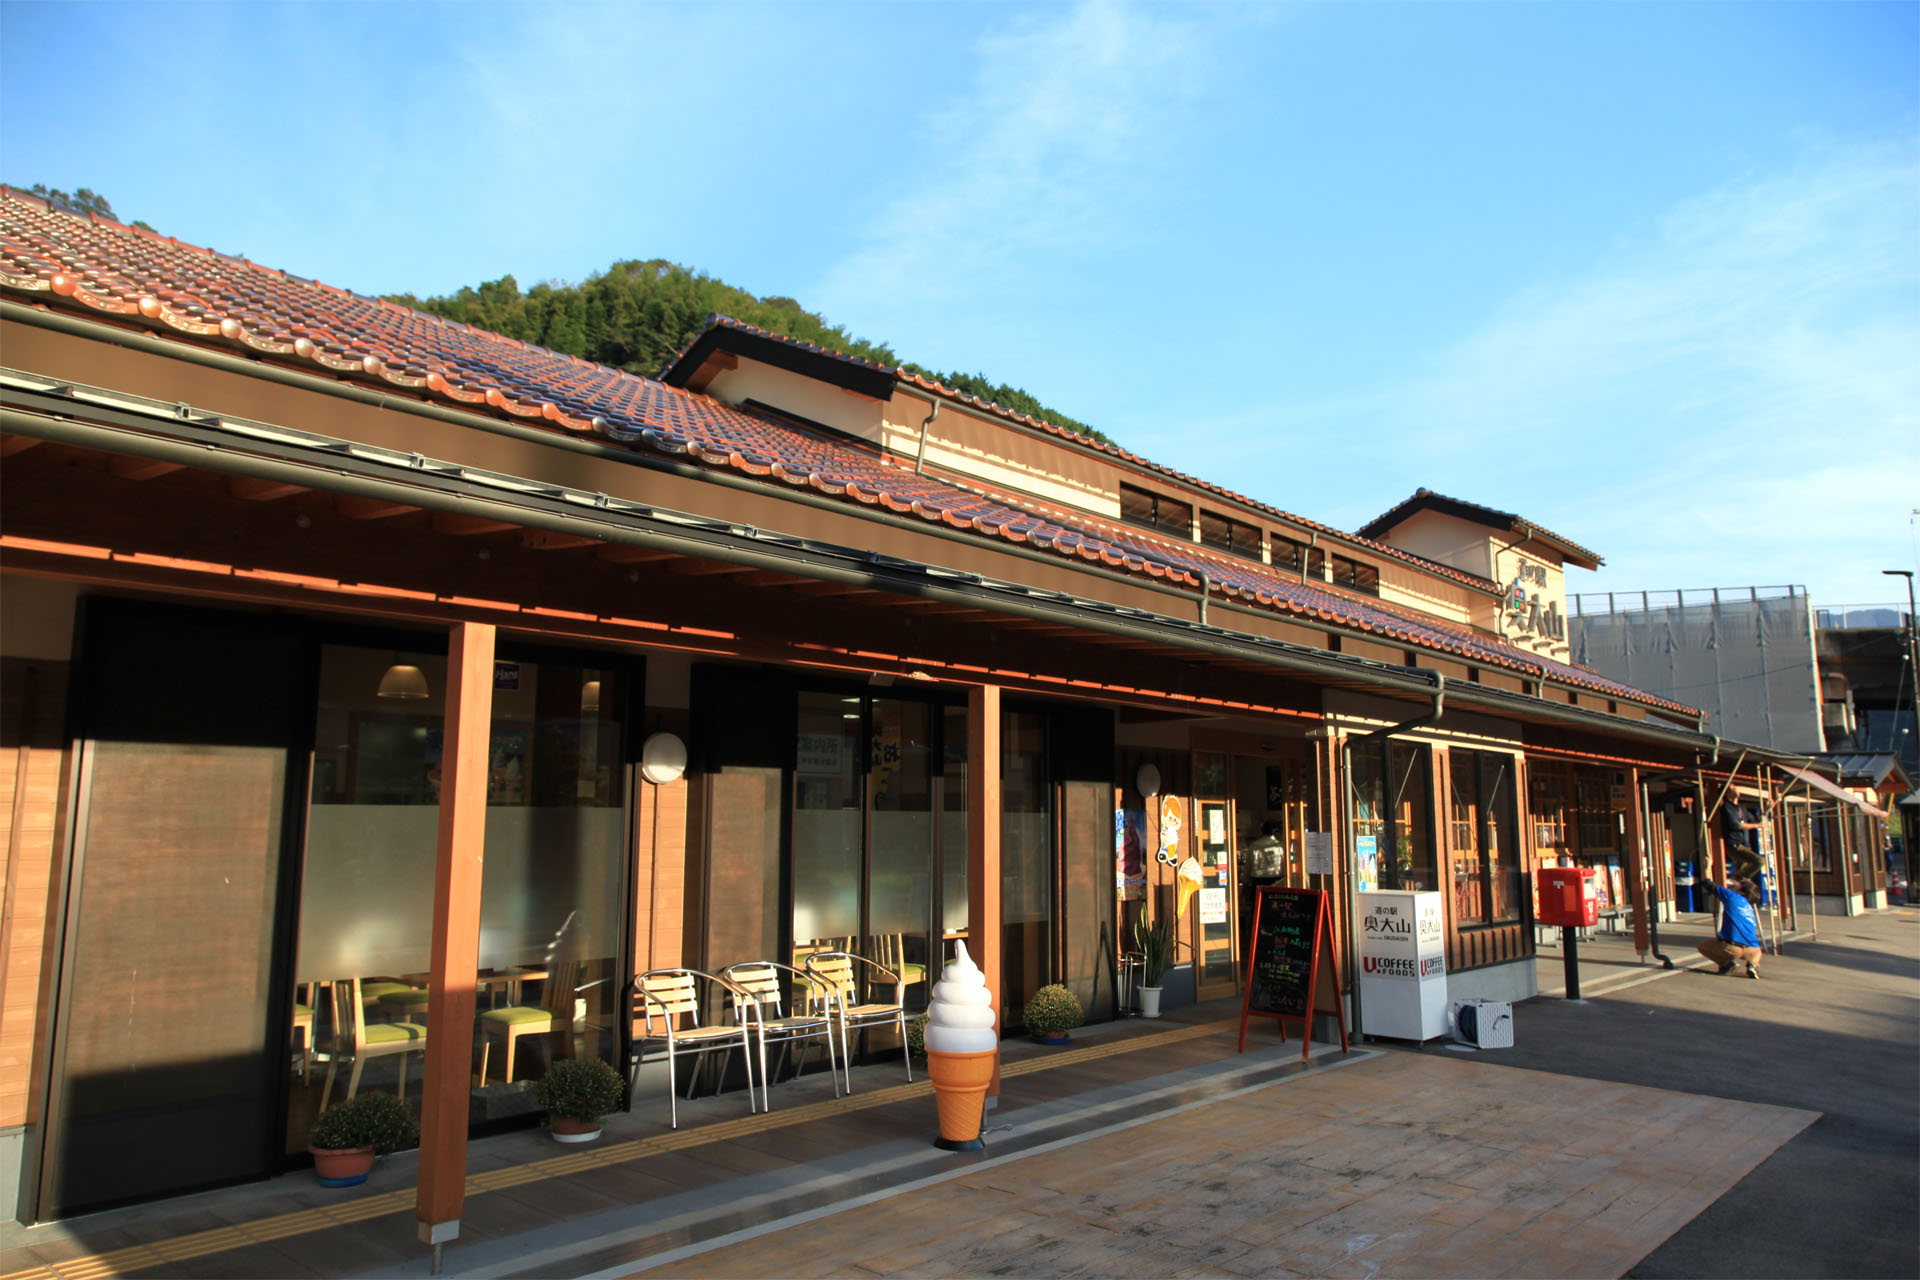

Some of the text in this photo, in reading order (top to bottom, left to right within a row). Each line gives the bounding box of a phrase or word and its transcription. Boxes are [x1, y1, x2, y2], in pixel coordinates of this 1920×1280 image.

[1375, 906, 1398, 916] 道の駅
[1364, 914, 1411, 934] 奥大山
[1378, 957, 1415, 970] COFFEE
[1428, 956, 1443, 969] COFFEE
[1383, 968, 1416, 977] FOODS
